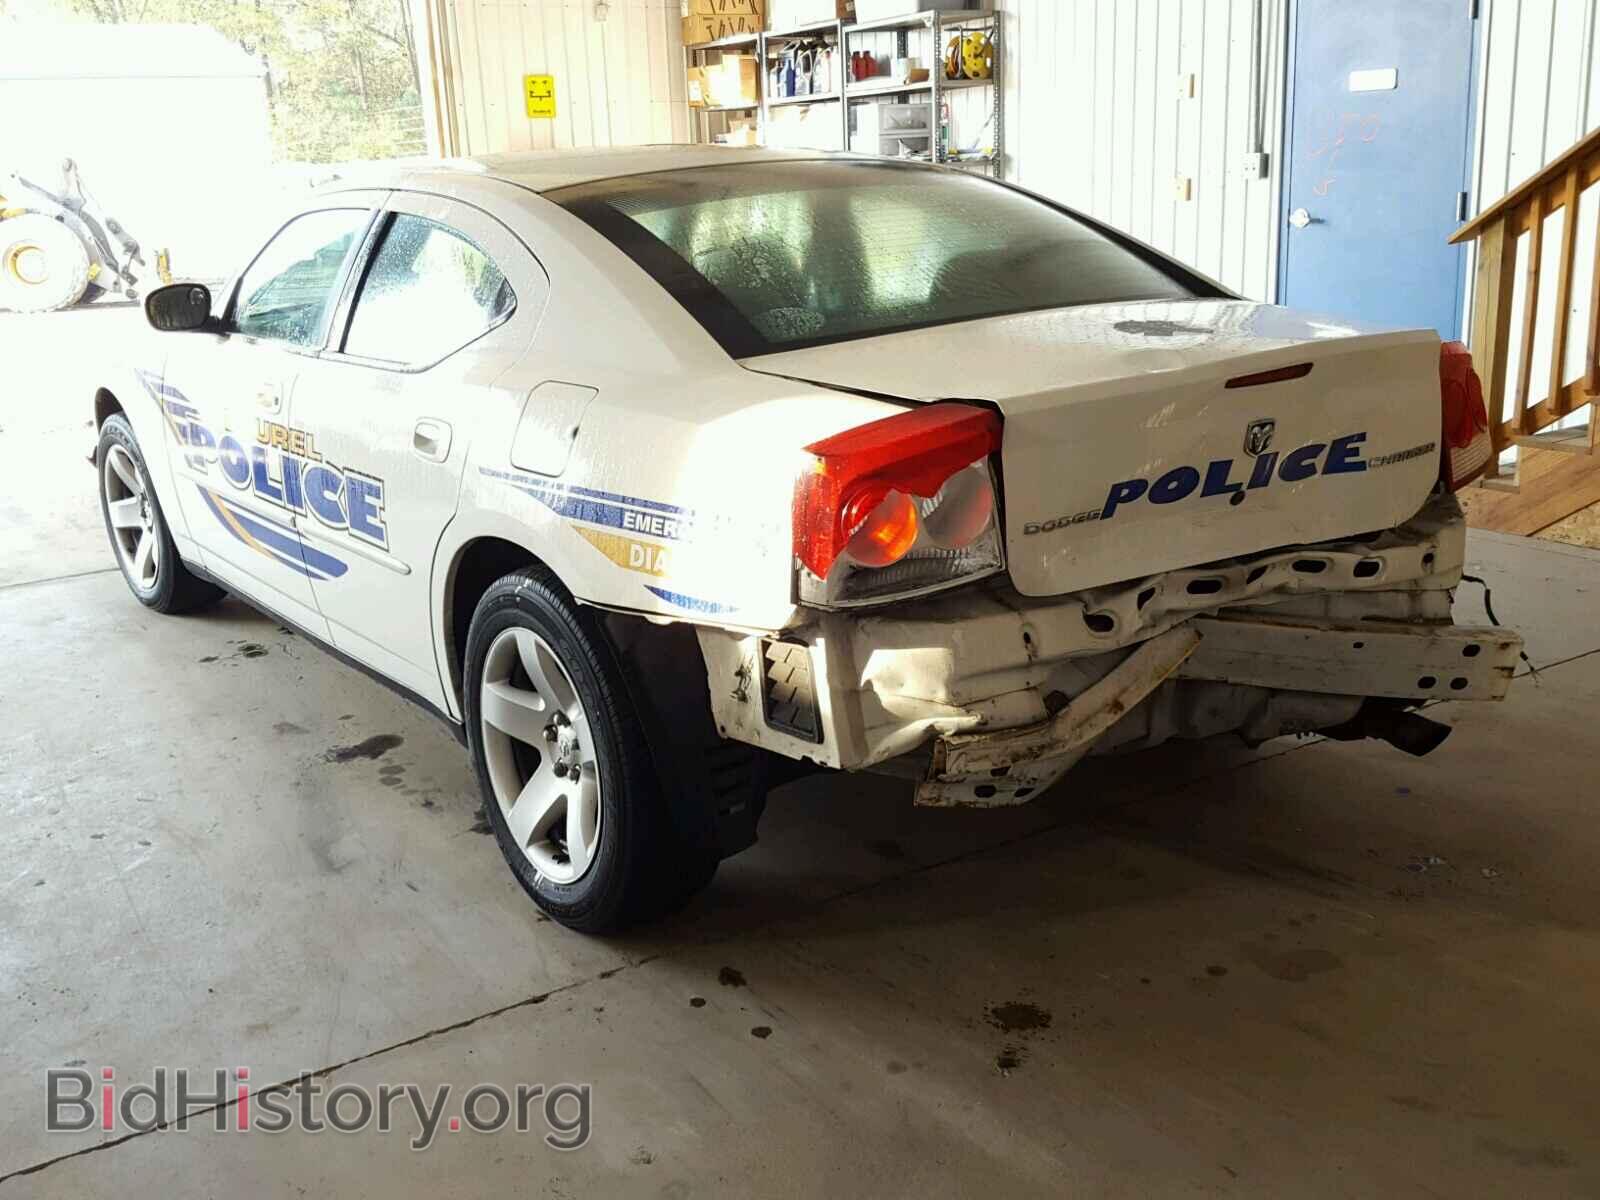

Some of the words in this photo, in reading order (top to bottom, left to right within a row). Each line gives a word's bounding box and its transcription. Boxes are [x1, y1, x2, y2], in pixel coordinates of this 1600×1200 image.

[255, 416, 322, 462] UREL
[182, 423, 390, 552] POLICE
[1101, 432, 1366, 519] POLICE
[623, 510, 680, 539] EMER
[1023, 508, 1101, 535] DODGE
